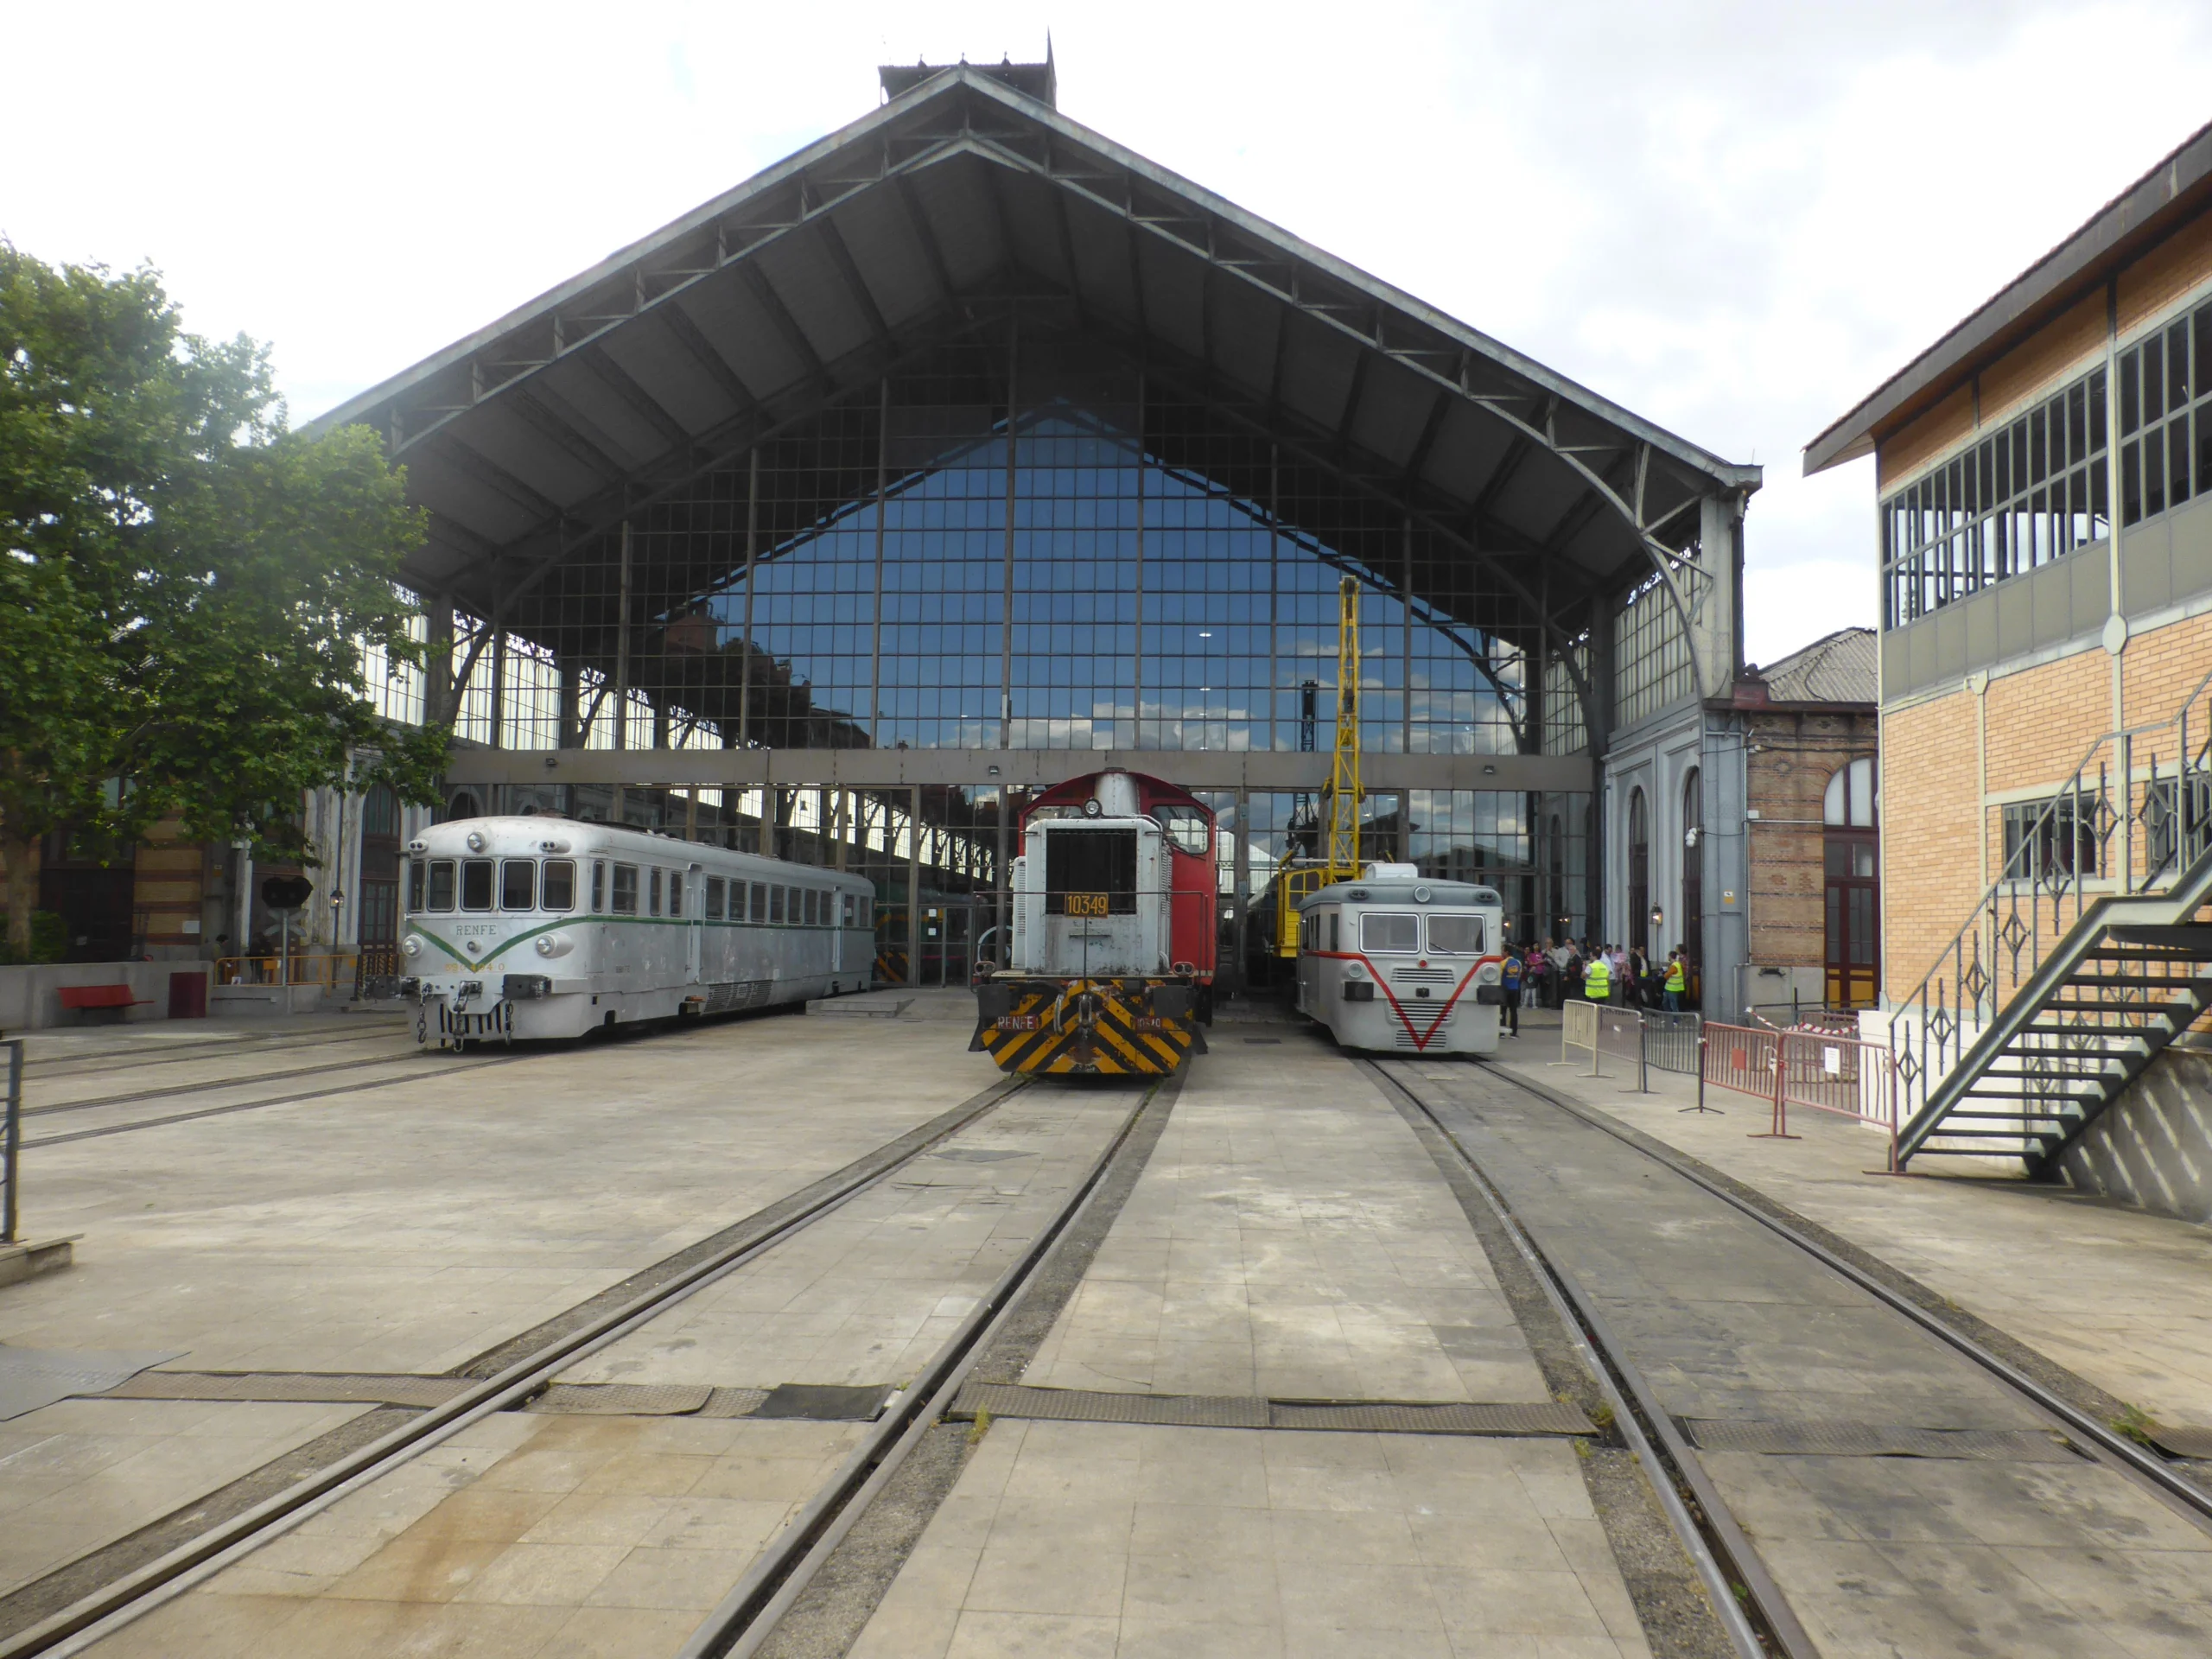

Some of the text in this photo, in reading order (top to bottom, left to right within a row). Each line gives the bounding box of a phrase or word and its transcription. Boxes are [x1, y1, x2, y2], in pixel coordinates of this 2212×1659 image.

[1068, 895, 1107, 914] 10349
[456, 925, 497, 935] RENFE
[997, 1015, 1034, 1029] RENFE
